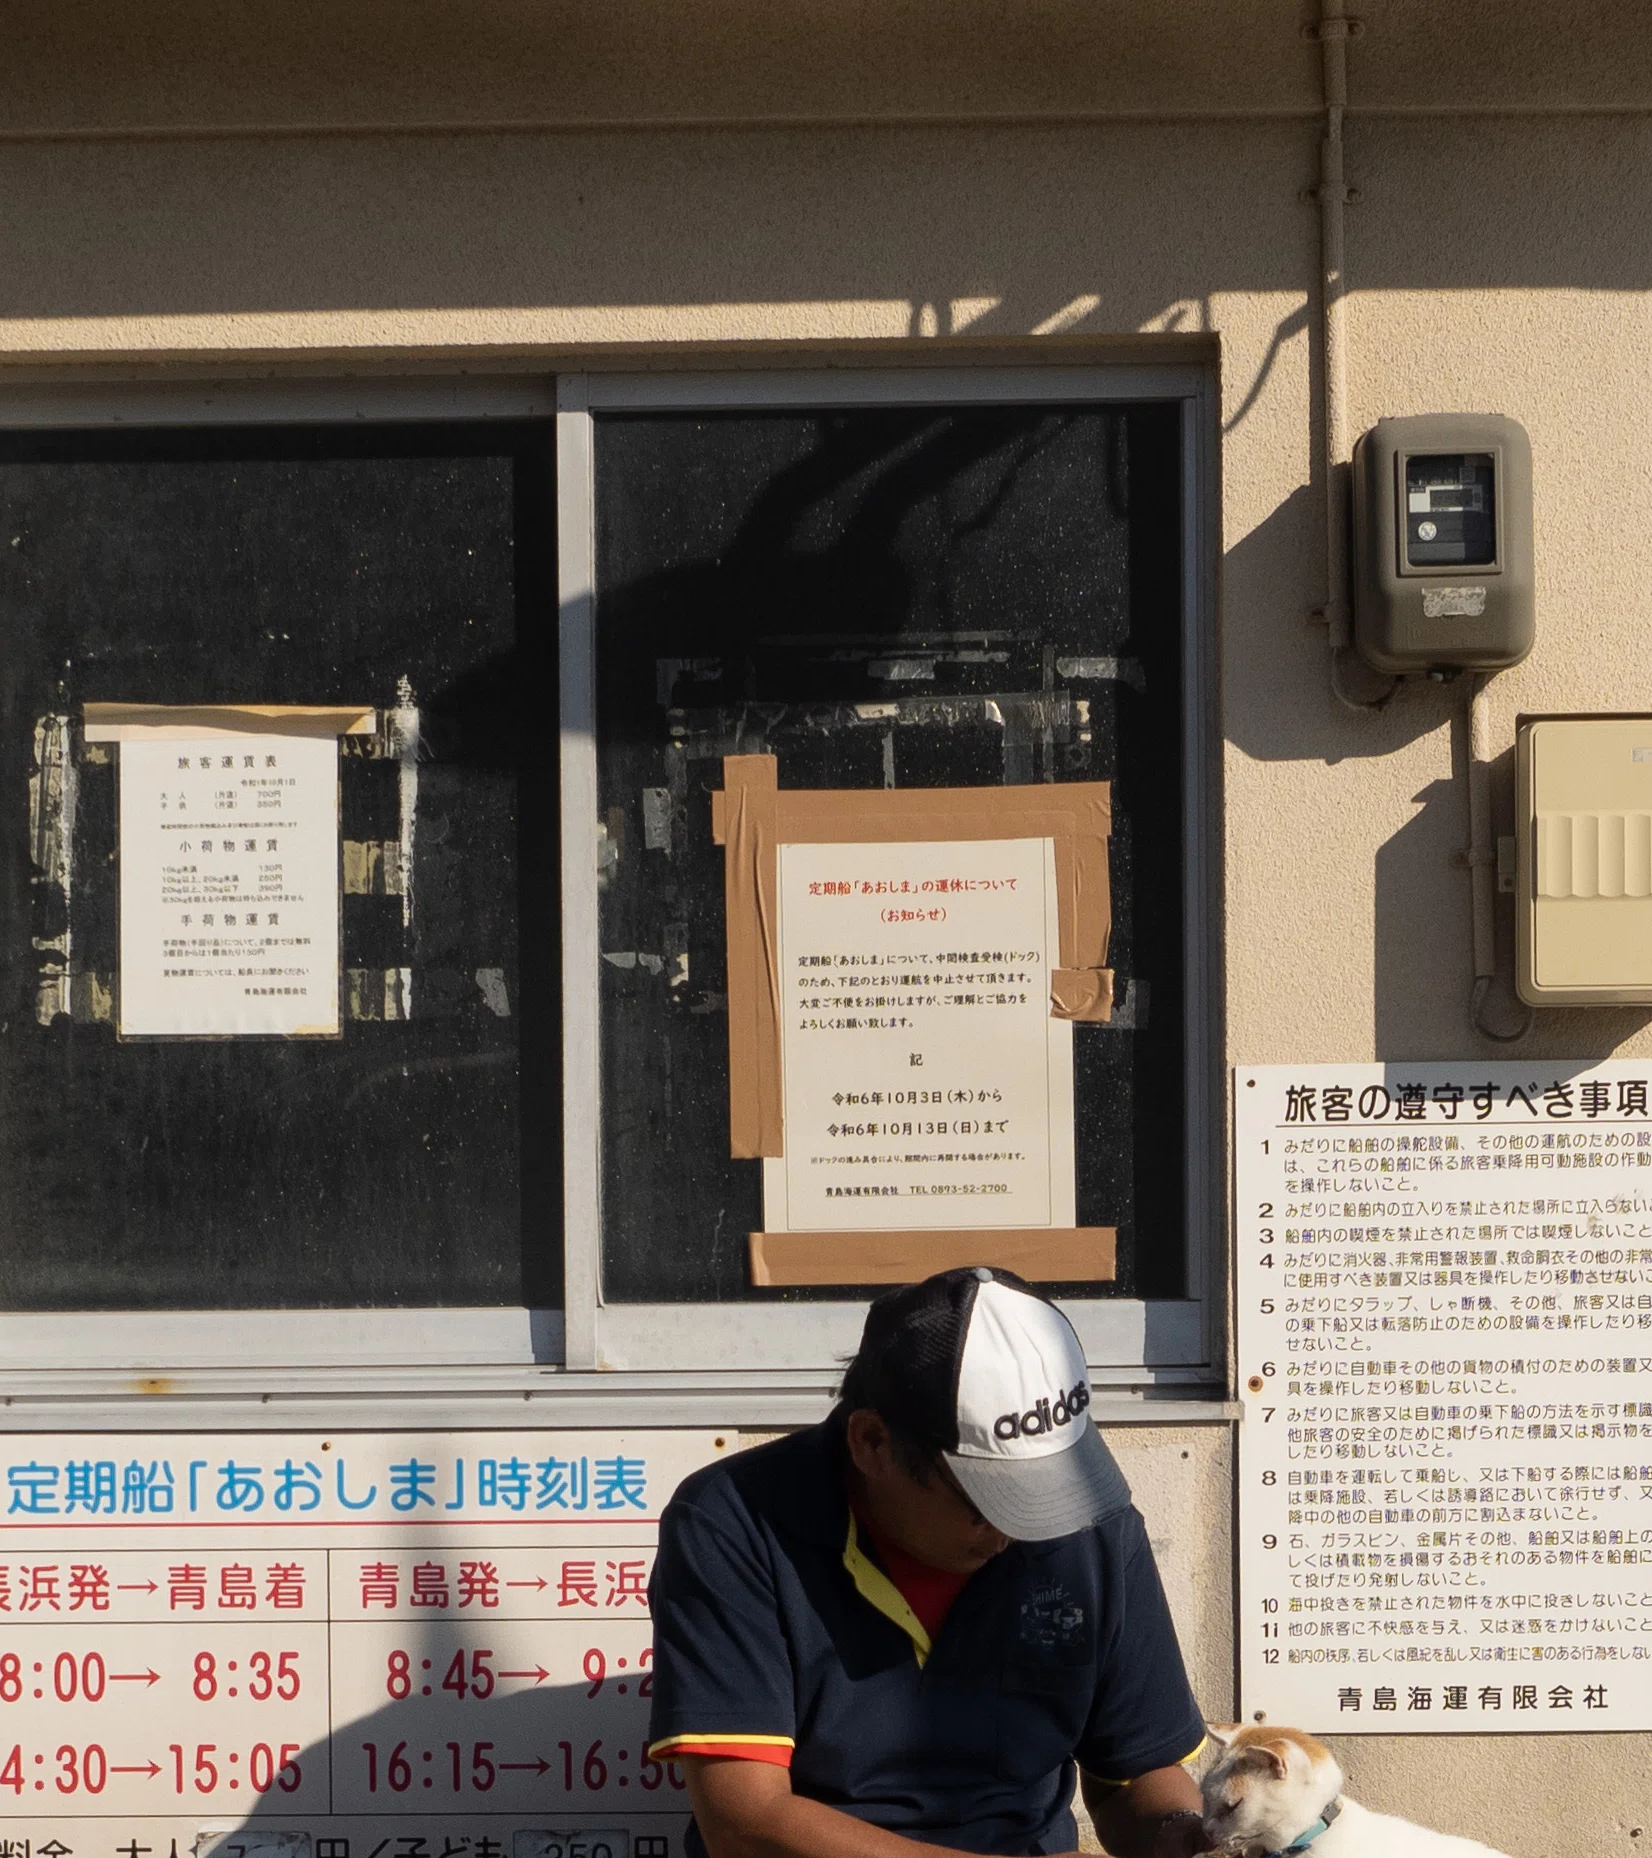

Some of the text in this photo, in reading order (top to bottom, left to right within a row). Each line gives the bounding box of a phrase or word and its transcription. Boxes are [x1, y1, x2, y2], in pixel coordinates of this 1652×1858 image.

[810, 879, 1016, 895] 定期船「あおしま」の運休について
[881, 908, 946, 922] (お知らせ)
[910, 1053, 923, 1066] 記
[1284, 1079, 1650, 1123] 旅客の遵守すべき事項
[1261, 1140, 1268, 1154] 1
[909, 1185, 929, 1194] TEL
[1286, 1176, 1418, 1193] を操作しないこと。
[1259, 1203, 1273, 1218] 2
[1260, 1229, 1274, 1243] 3
[1260, 1254, 1274, 1268] 4
[1261, 1299, 1274, 1314] 5
[1286, 1337, 1371, 1351] せないこと。
[1262, 1362, 1275, 1377] 6
[1288, 1380, 1516, 1396] 具を操作したり移動しないこと。
[994, 1381, 1090, 1441] adidas
[1262, 1408, 1275, 1422] 7
[1289, 1443, 1452, 1459] したり移動しないこと。
[1262, 1471, 1276, 1485] 8
[6, 1455, 649, 1517] 定期船「あおしま」時刻表
[1262, 1535, 1277, 1549] 9
[168, 1563, 305, 1610] 青島着
[360, 1561, 498, 1610] 青島発
[1290, 1572, 1485, 1588] て投げたり発射しないこと。
[1262, 1598, 1278, 1613] 10
[1263, 1649, 1279, 1663] 12
[0, 1652, 105, 1702] 8:00
[194, 1652, 300, 1701] 8:35
[385, 1648, 496, 1699] 8:45
[1338, 1684, 1608, 1711] 青島海運有限会社
[168, 1742, 302, 1794] 15:05
[362, 1740, 496, 1792] 16:15
